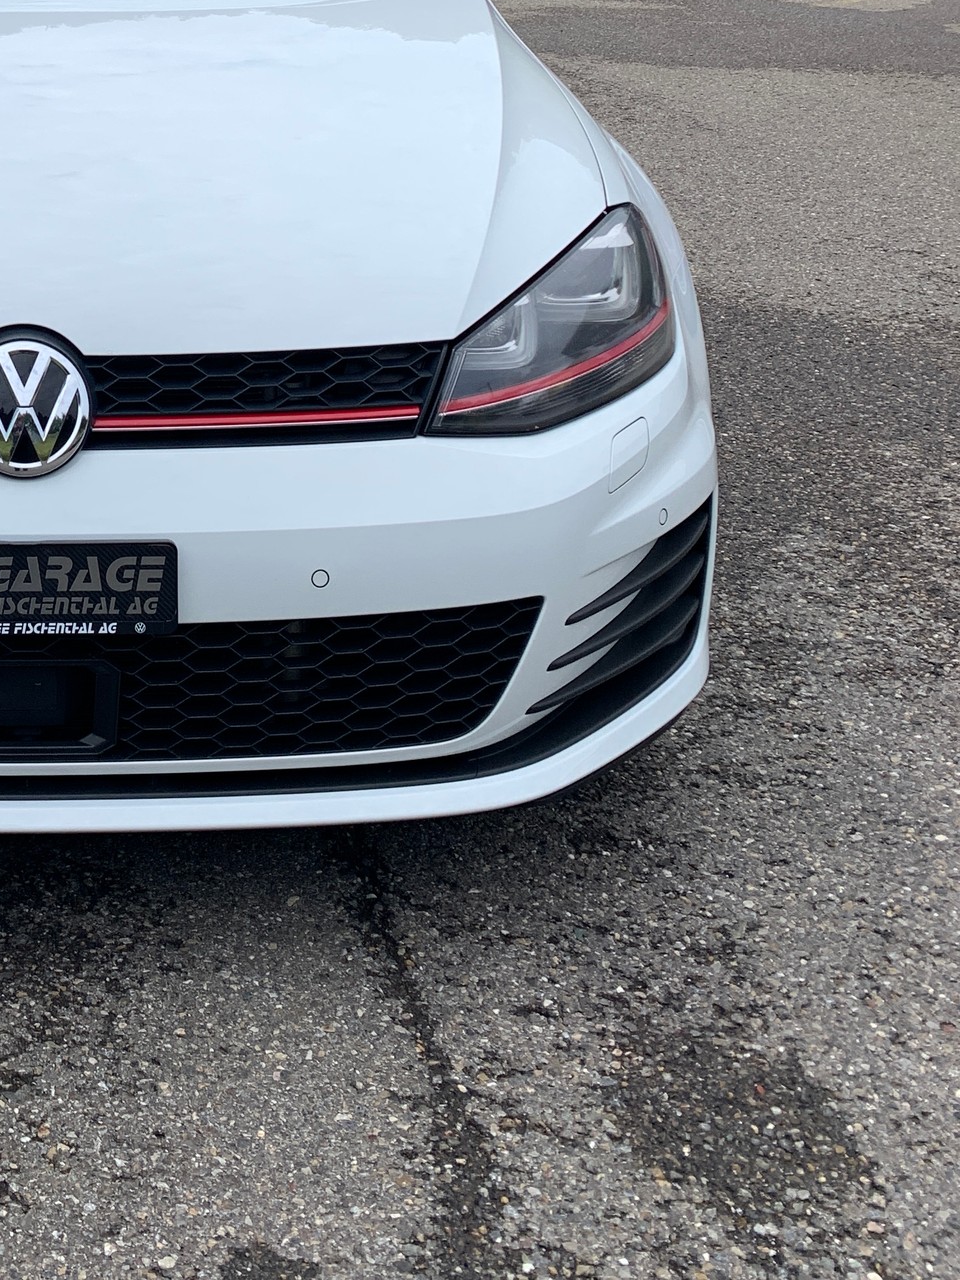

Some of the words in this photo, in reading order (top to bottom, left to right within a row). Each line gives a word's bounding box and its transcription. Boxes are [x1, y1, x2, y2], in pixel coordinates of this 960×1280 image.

[125, 596, 159, 615] AG
[13, 622, 95, 635] FISCHENTHAL
[98, 622, 118, 634] AG
